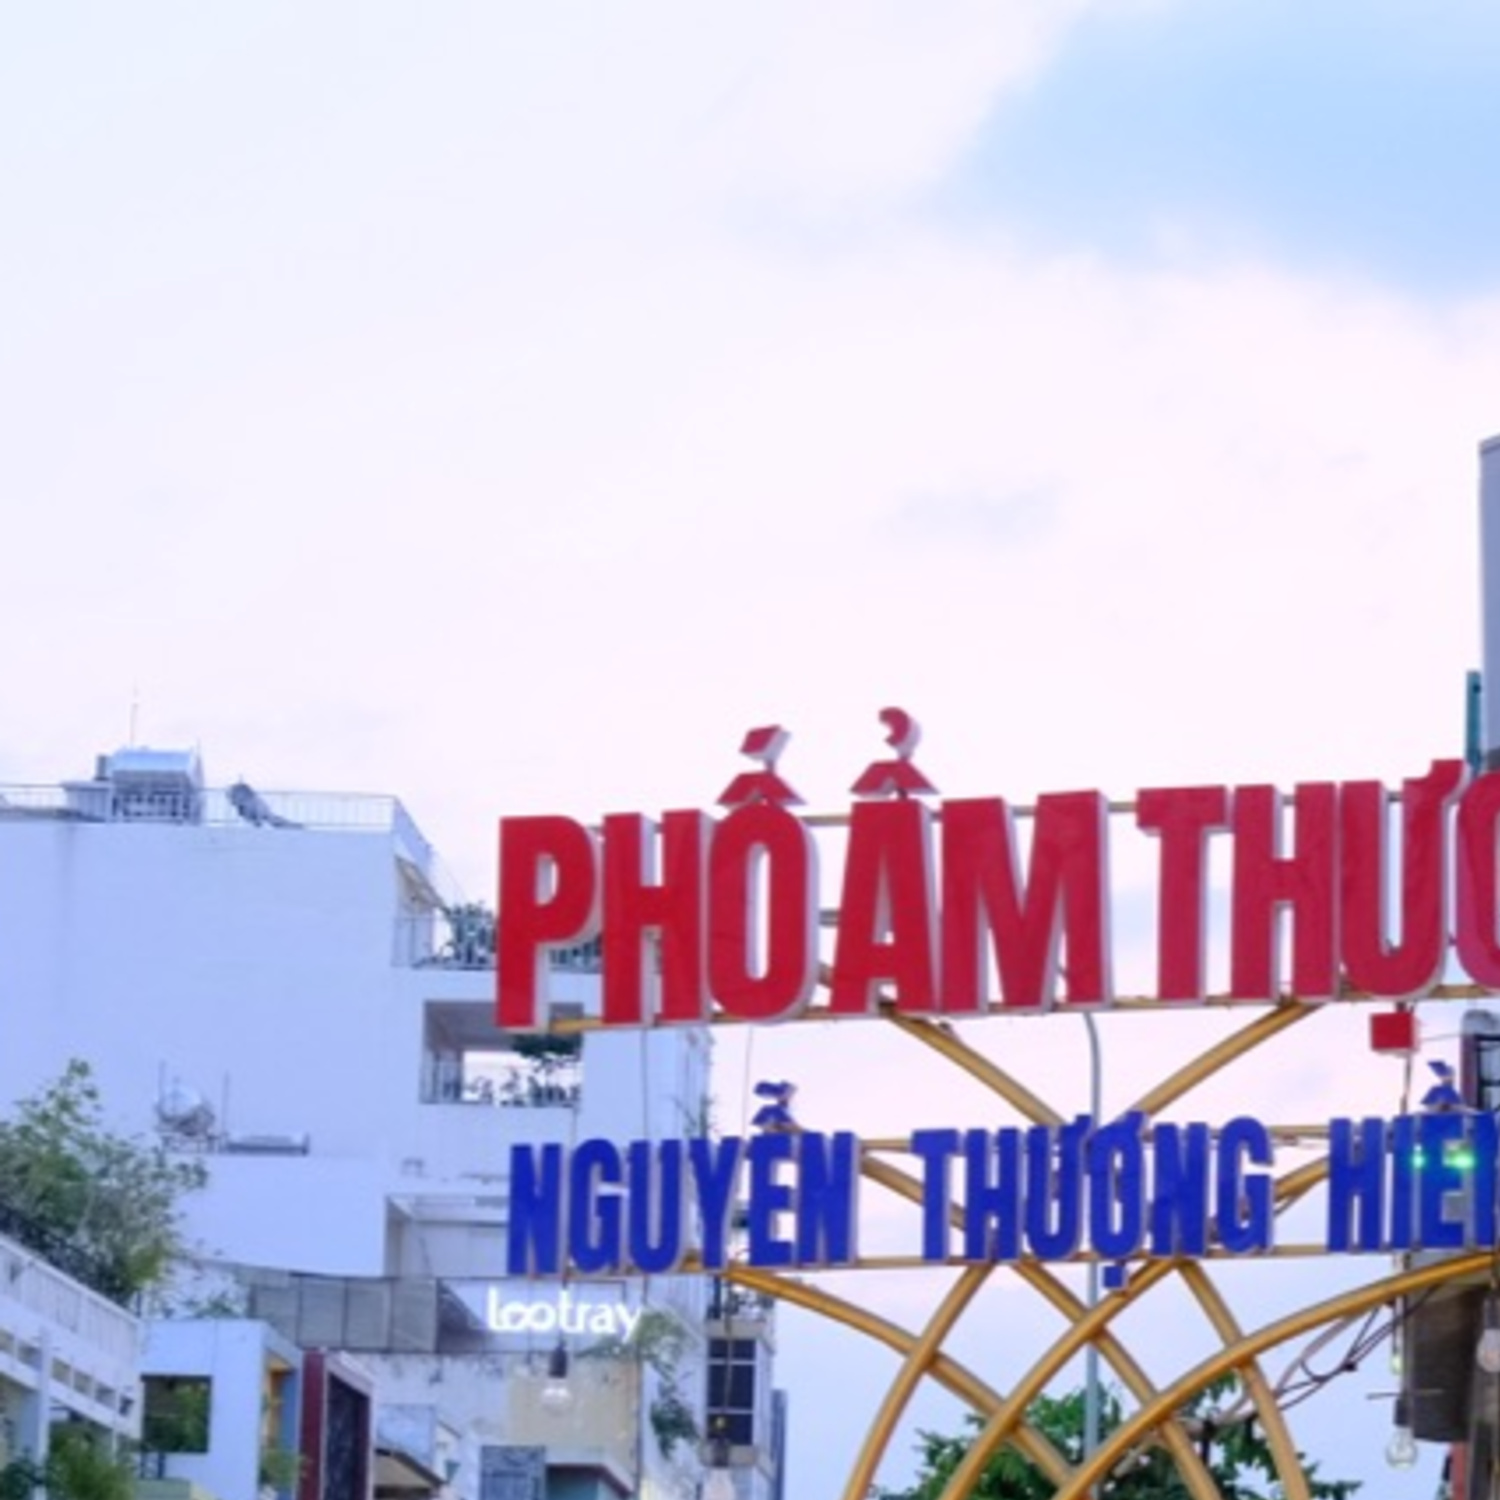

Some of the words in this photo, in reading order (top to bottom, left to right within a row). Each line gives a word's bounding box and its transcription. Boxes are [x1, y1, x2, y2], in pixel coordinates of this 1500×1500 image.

[496, 725, 820, 1032] PHỐ
[830, 706, 1108, 1016] ẨM
[507, 1081, 859, 1276] NGUYỄN
[911, 1110, 1275, 1290] THƯỢNG
